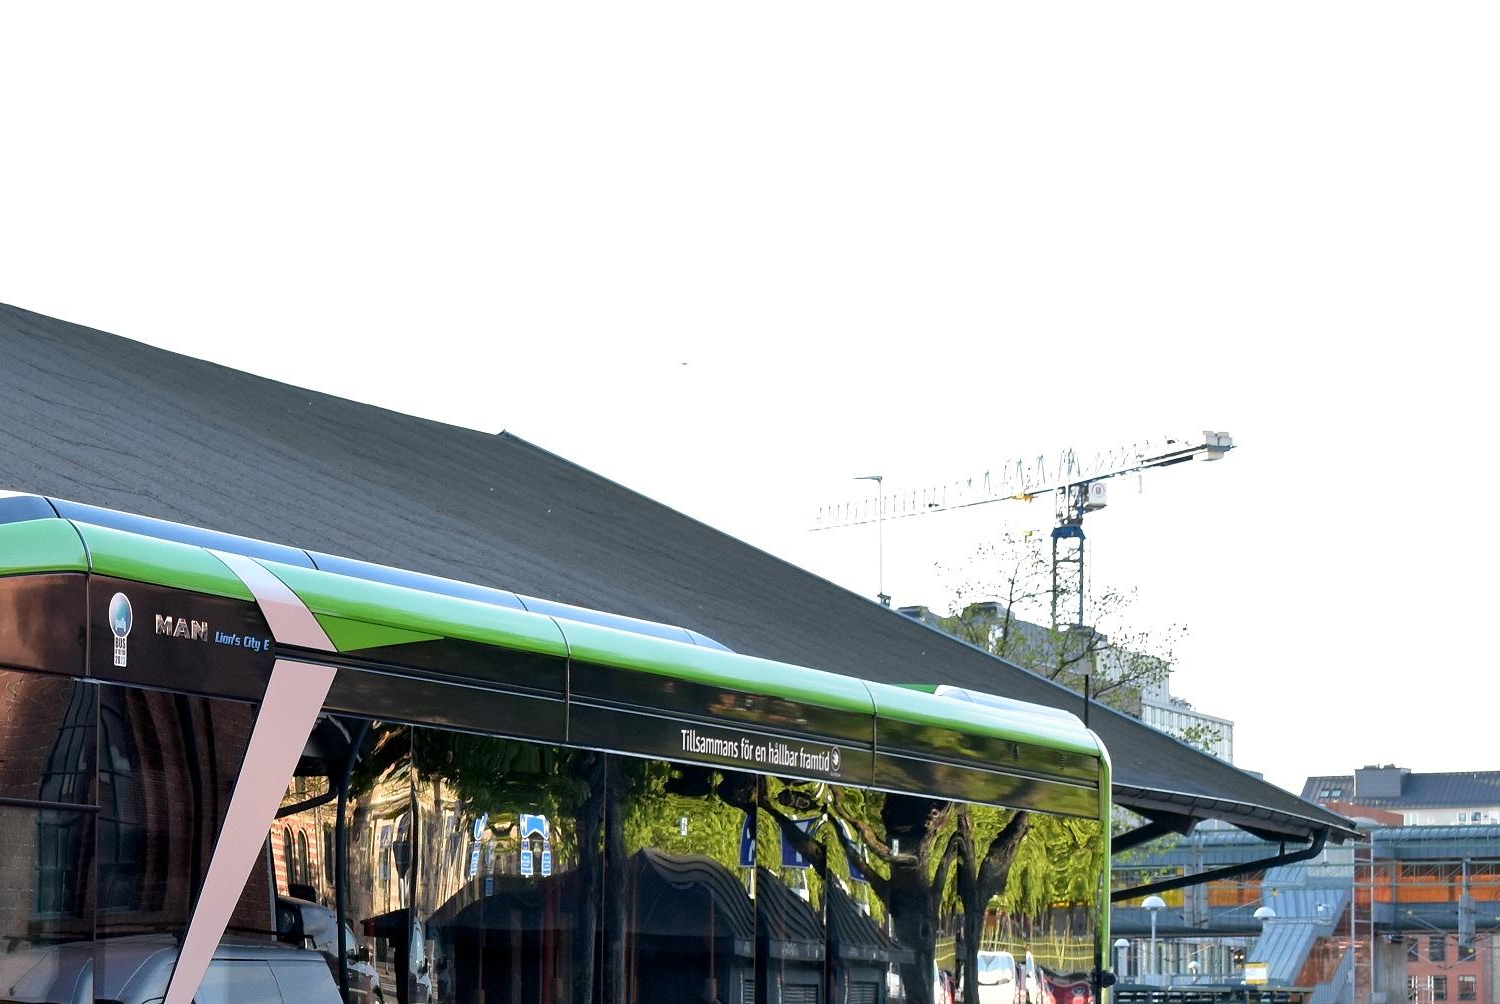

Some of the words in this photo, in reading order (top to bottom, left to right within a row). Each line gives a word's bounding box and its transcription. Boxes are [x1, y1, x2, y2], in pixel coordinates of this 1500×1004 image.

[155, 613, 209, 642] MAN
[215, 631, 240, 647] Lion's
[244, 636, 260, 651] City
[264, 639, 270, 651] E
[681, 729, 739, 758] Tillsammans
[740, 738, 754, 760] för
[755, 745, 767, 764] en
[768, 742, 799, 768] hållbar
[799, 747, 830, 772] framtid
